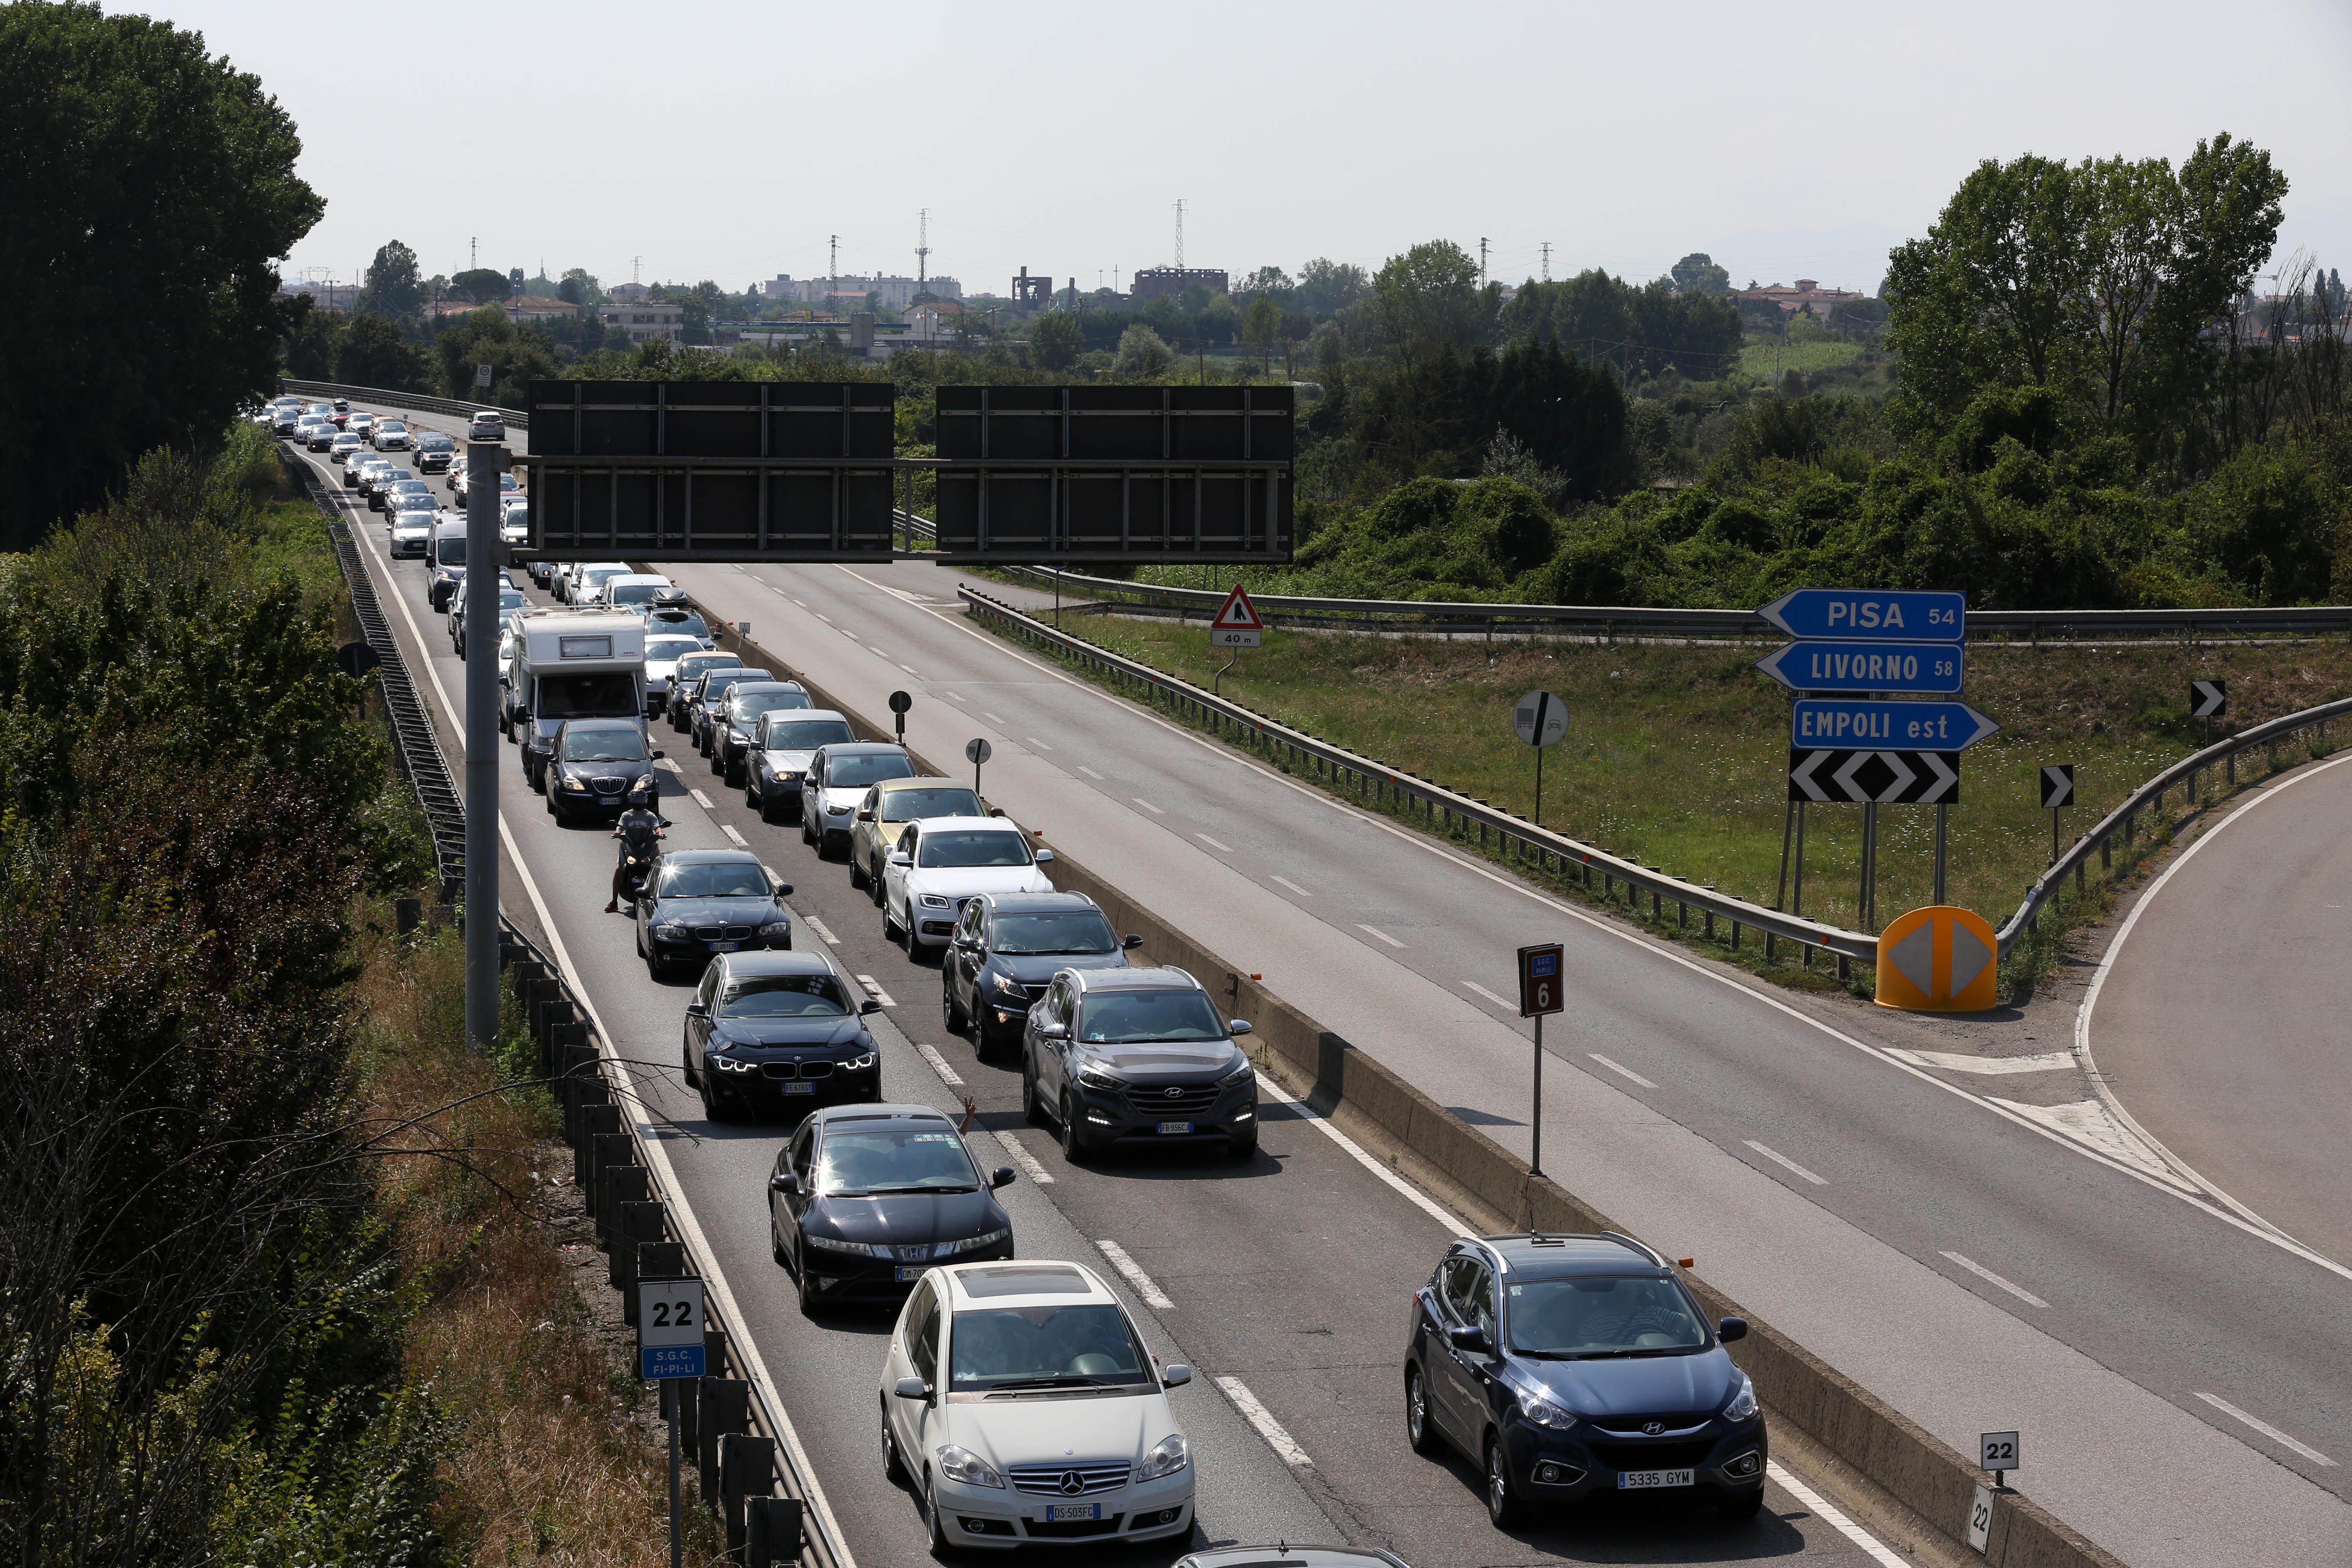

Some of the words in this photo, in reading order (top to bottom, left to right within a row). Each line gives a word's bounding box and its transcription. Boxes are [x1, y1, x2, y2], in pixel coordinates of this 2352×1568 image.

[1828, 602, 1905, 628] PISA
[1929, 609, 1955, 625] 54
[1225, 635, 1240, 643] 40
[1812, 653, 1918, 679] LIVORNO
[1934, 661, 1953, 676] 58
[1801, 711, 1889, 737] EMPOLI
[1907, 715, 1948, 738] est
[1538, 983, 1549, 1007] 6
[653, 1301, 692, 1327] 22
[656, 1351, 691, 1361] S.G.C.
[653, 1364, 695, 1374] FI-PI-LI
[1987, 1442, 2012, 1460] 22
[1629, 1473, 1659, 1486] 5335
[1666, 1471, 1690, 1484] GYM
[1055, 1508, 1064, 1518] DS
[1973, 1503, 1988, 1533] 22
